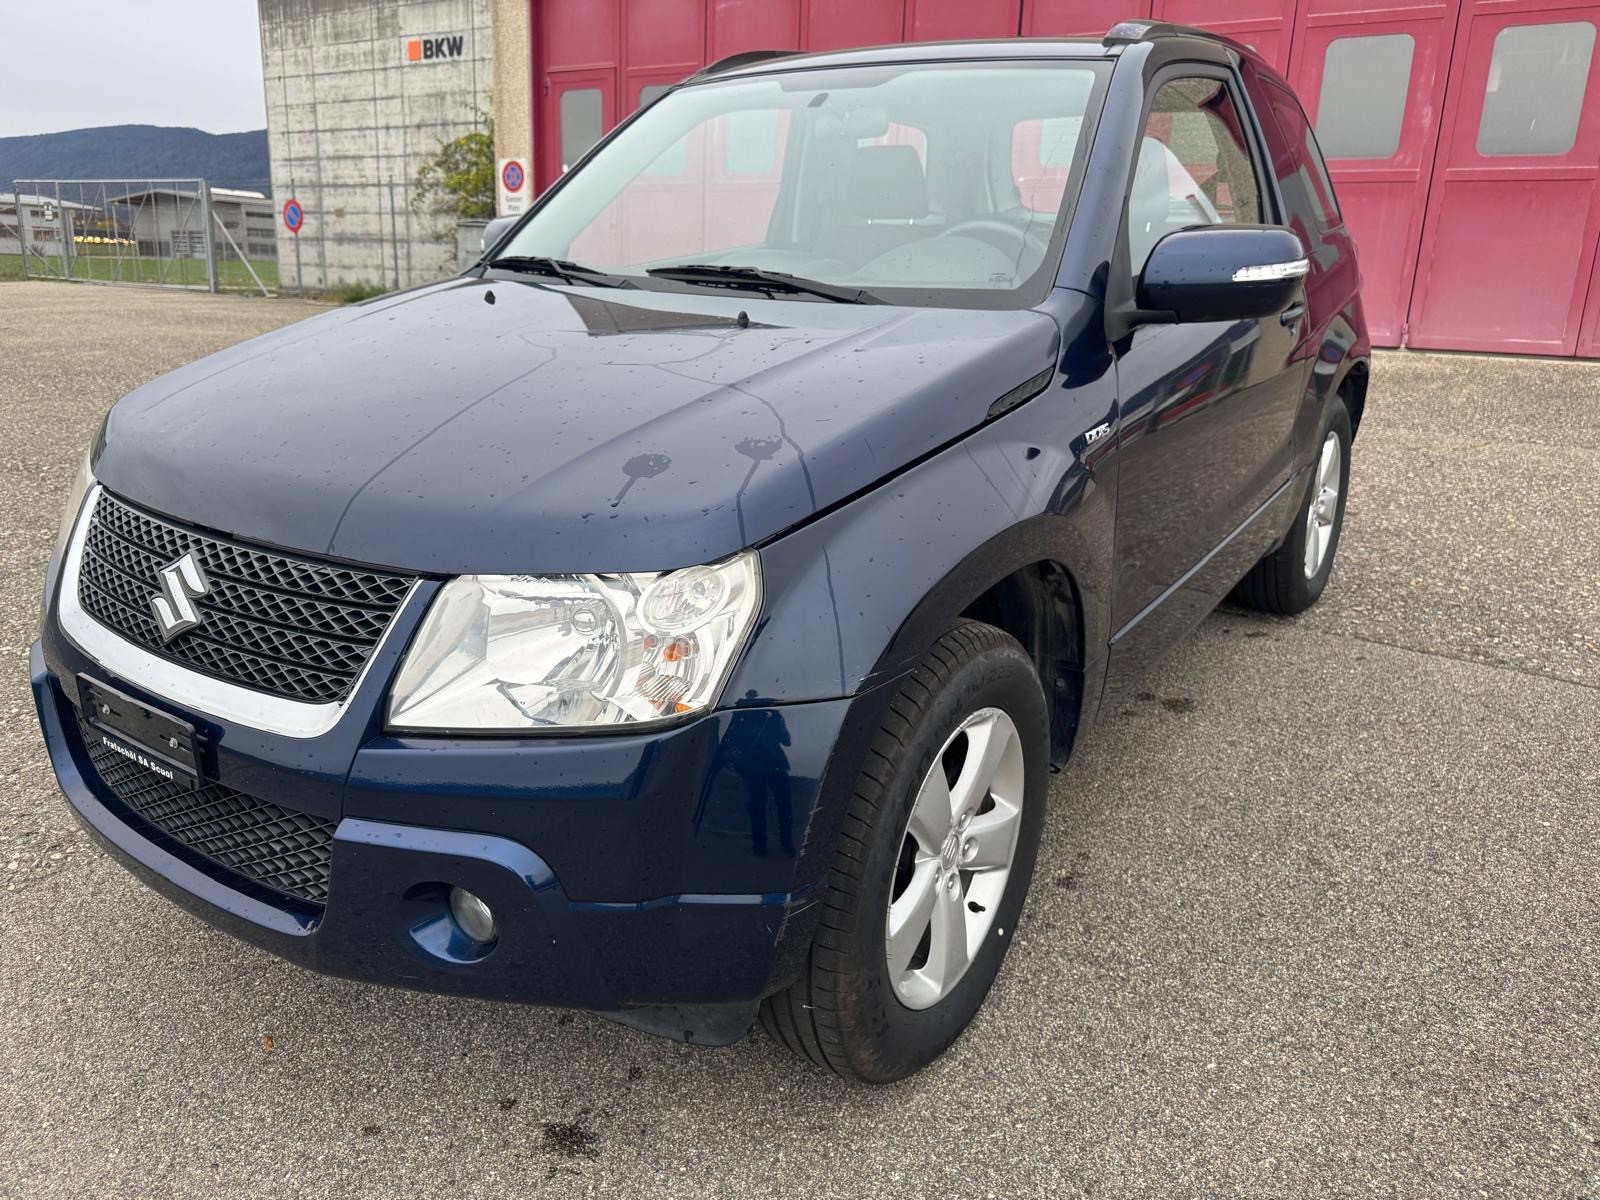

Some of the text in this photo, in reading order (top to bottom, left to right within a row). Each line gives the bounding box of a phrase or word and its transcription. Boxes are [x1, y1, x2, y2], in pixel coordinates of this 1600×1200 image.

[423, 35, 463, 59] BKW
[138, 755, 149, 768] SA
[150, 761, 174, 780] Scuol
